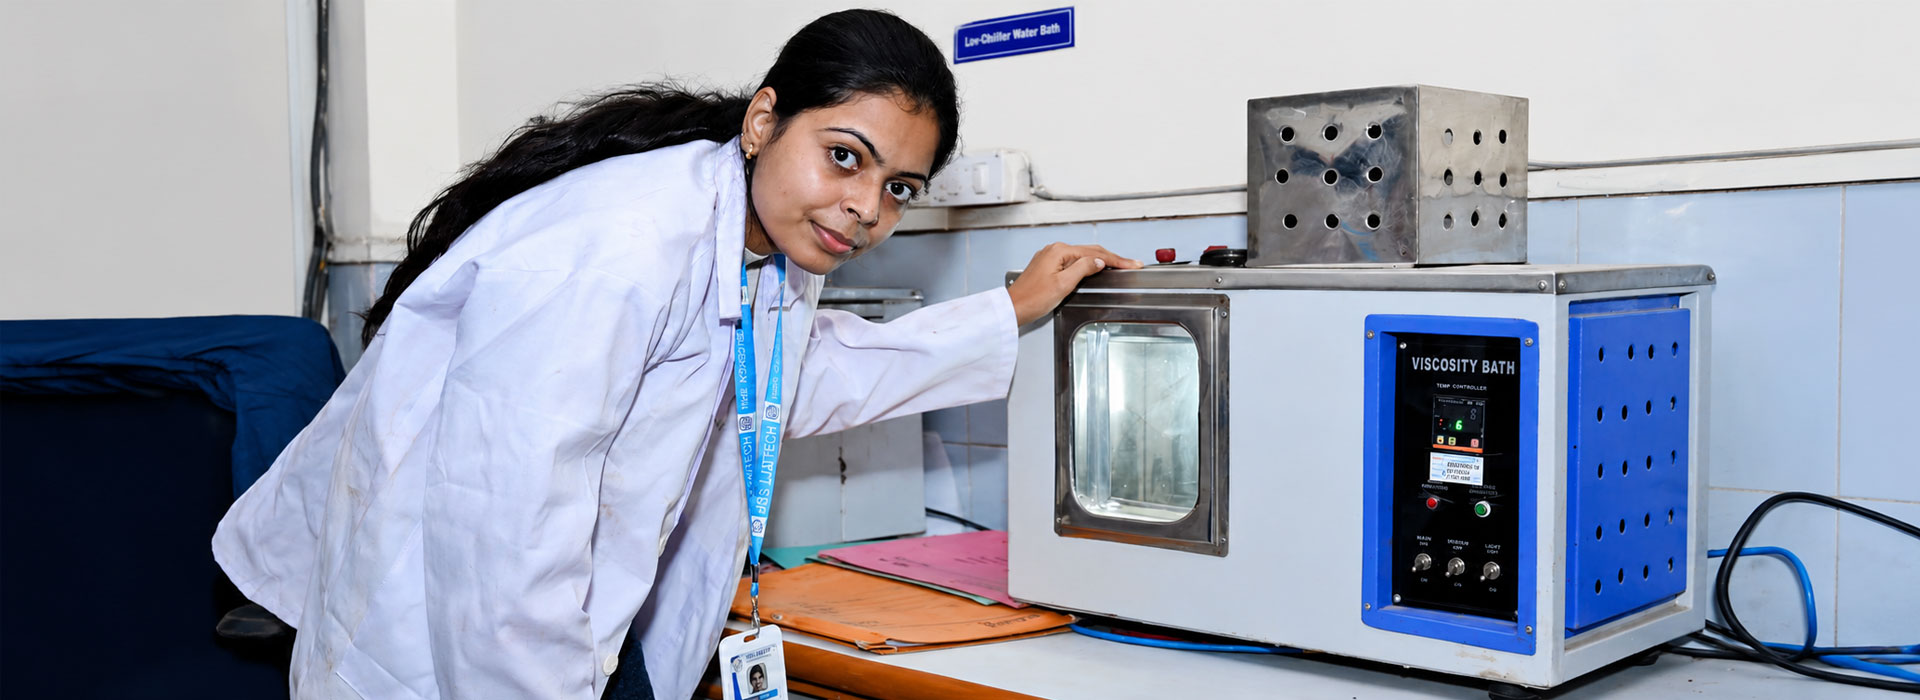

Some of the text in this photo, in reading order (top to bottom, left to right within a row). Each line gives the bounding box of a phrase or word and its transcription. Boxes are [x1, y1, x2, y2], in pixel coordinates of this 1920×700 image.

[1012, 28, 1039, 39] Water
[1040, 23, 1060, 36] Bath
[1411, 356, 1515, 375] VISCOSITY BATH
[1455, 419, 1463, 430] 6
